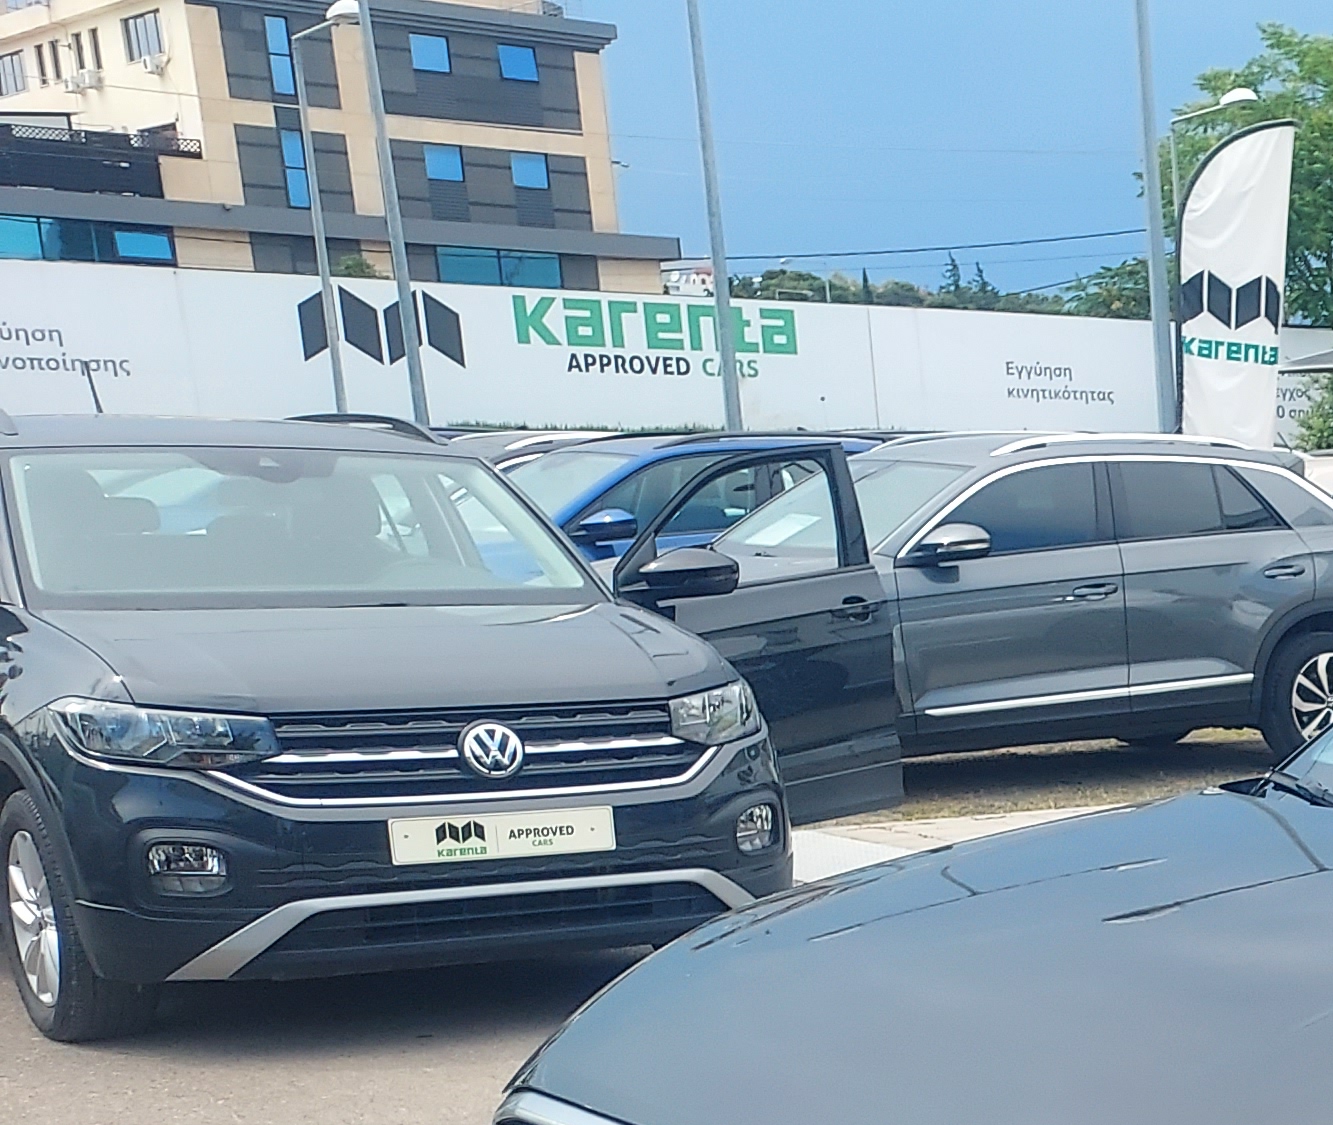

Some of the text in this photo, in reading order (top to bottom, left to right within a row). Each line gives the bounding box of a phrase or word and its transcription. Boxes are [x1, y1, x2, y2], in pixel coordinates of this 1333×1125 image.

[567, 353, 691, 376] APPROVED
[1005, 361, 1072, 381] Εγγύηση
[1007, 385, 1114, 405] κινητικότητας
[508, 825, 575, 840] APPROVED
[532, 838, 554, 847] CARS
